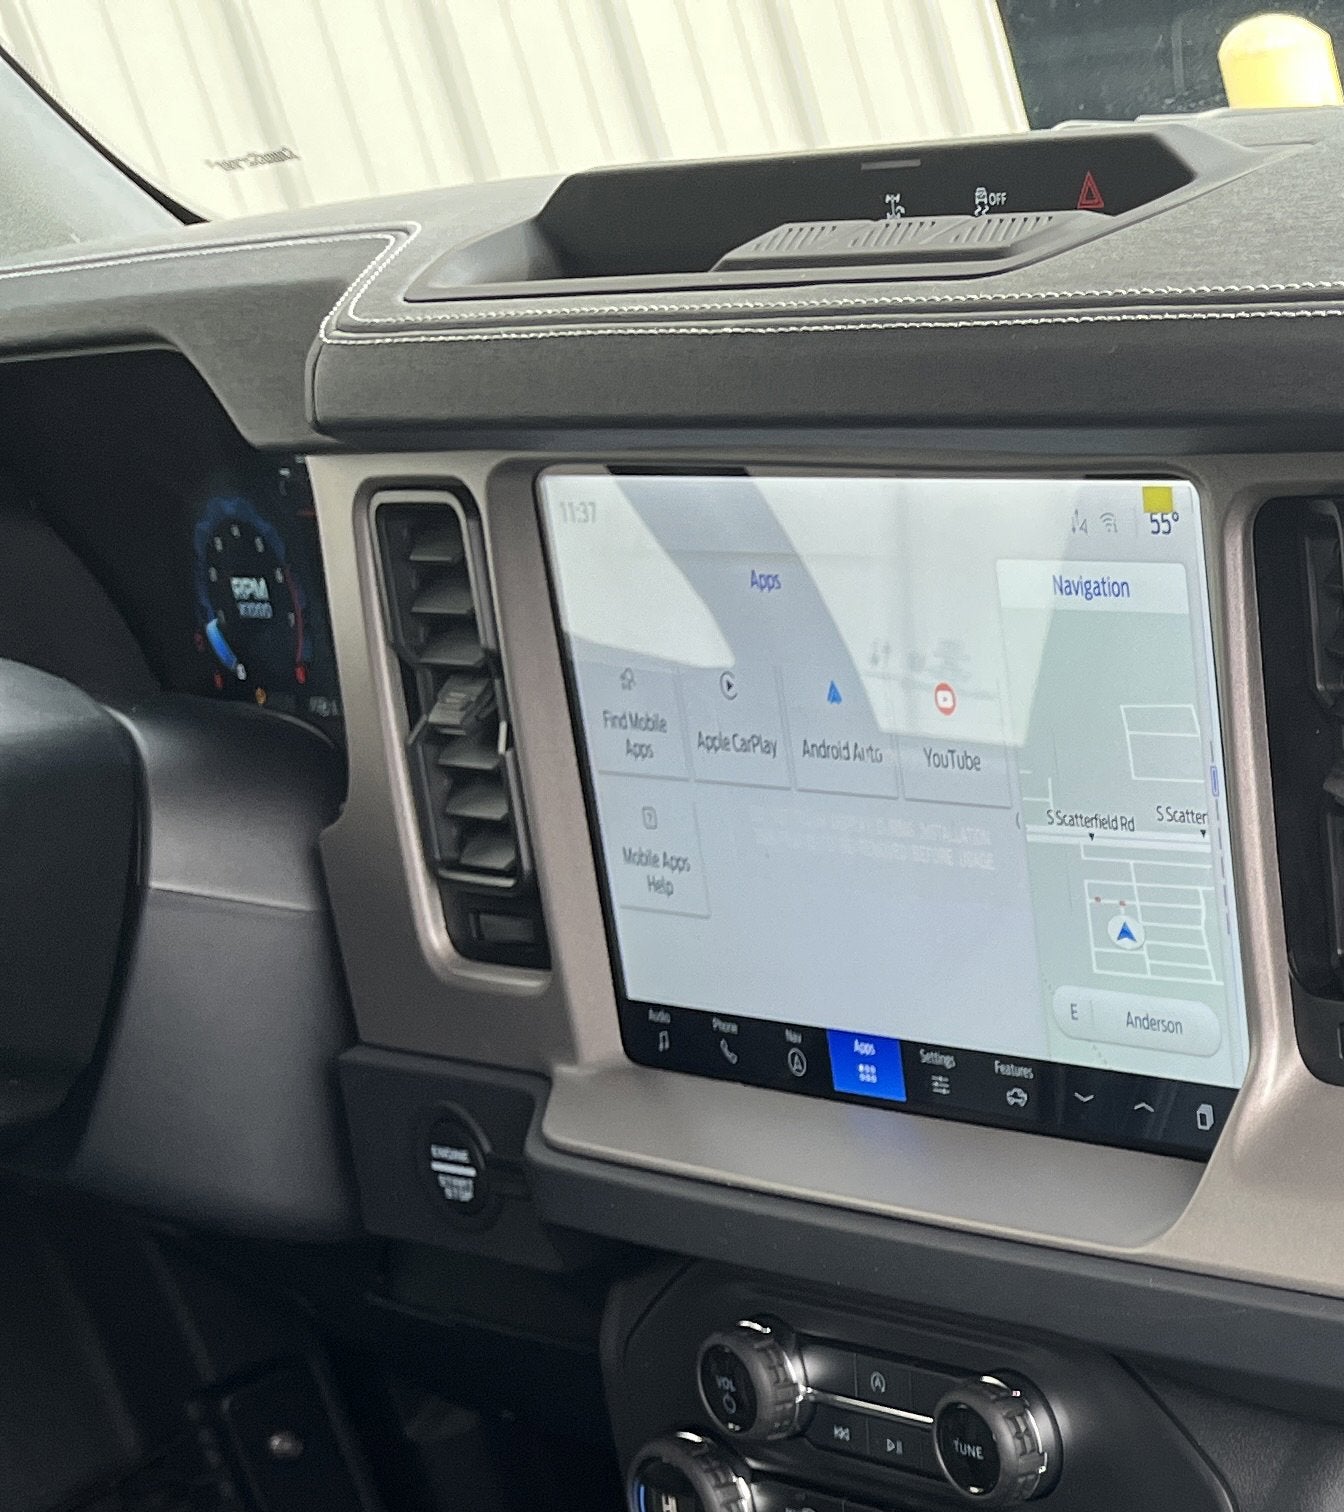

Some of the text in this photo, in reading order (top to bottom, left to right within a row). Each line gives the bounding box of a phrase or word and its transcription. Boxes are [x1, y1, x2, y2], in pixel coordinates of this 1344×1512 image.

[989, 192, 1006, 206] OFF
[750, 569, 782, 592] Apps
[1052, 574, 1131, 601] Navigation
[602, 710, 668, 734] Find Mobile
[625, 738, 654, 761] Apps
[697, 731, 778, 759] Apple CarPlay
[802, 739, 850, 761] Android
[923, 747, 982, 772] YouTube
[1047, 810, 1135, 832] S Scatterfield Rd
[1157, 806, 1164, 822] S
[622, 846, 691, 874] Mobile Apps
[647, 874, 674, 898] Help
[1070, 1003, 1183, 1035] E Anderson
[854, 1038, 876, 1056] Apps
[919, 1048, 956, 1069] Settings
[994, 1060, 1034, 1081] Features
[716, 1375, 736, 1393] VOL
[953, 1437, 984, 1460] TUNE
